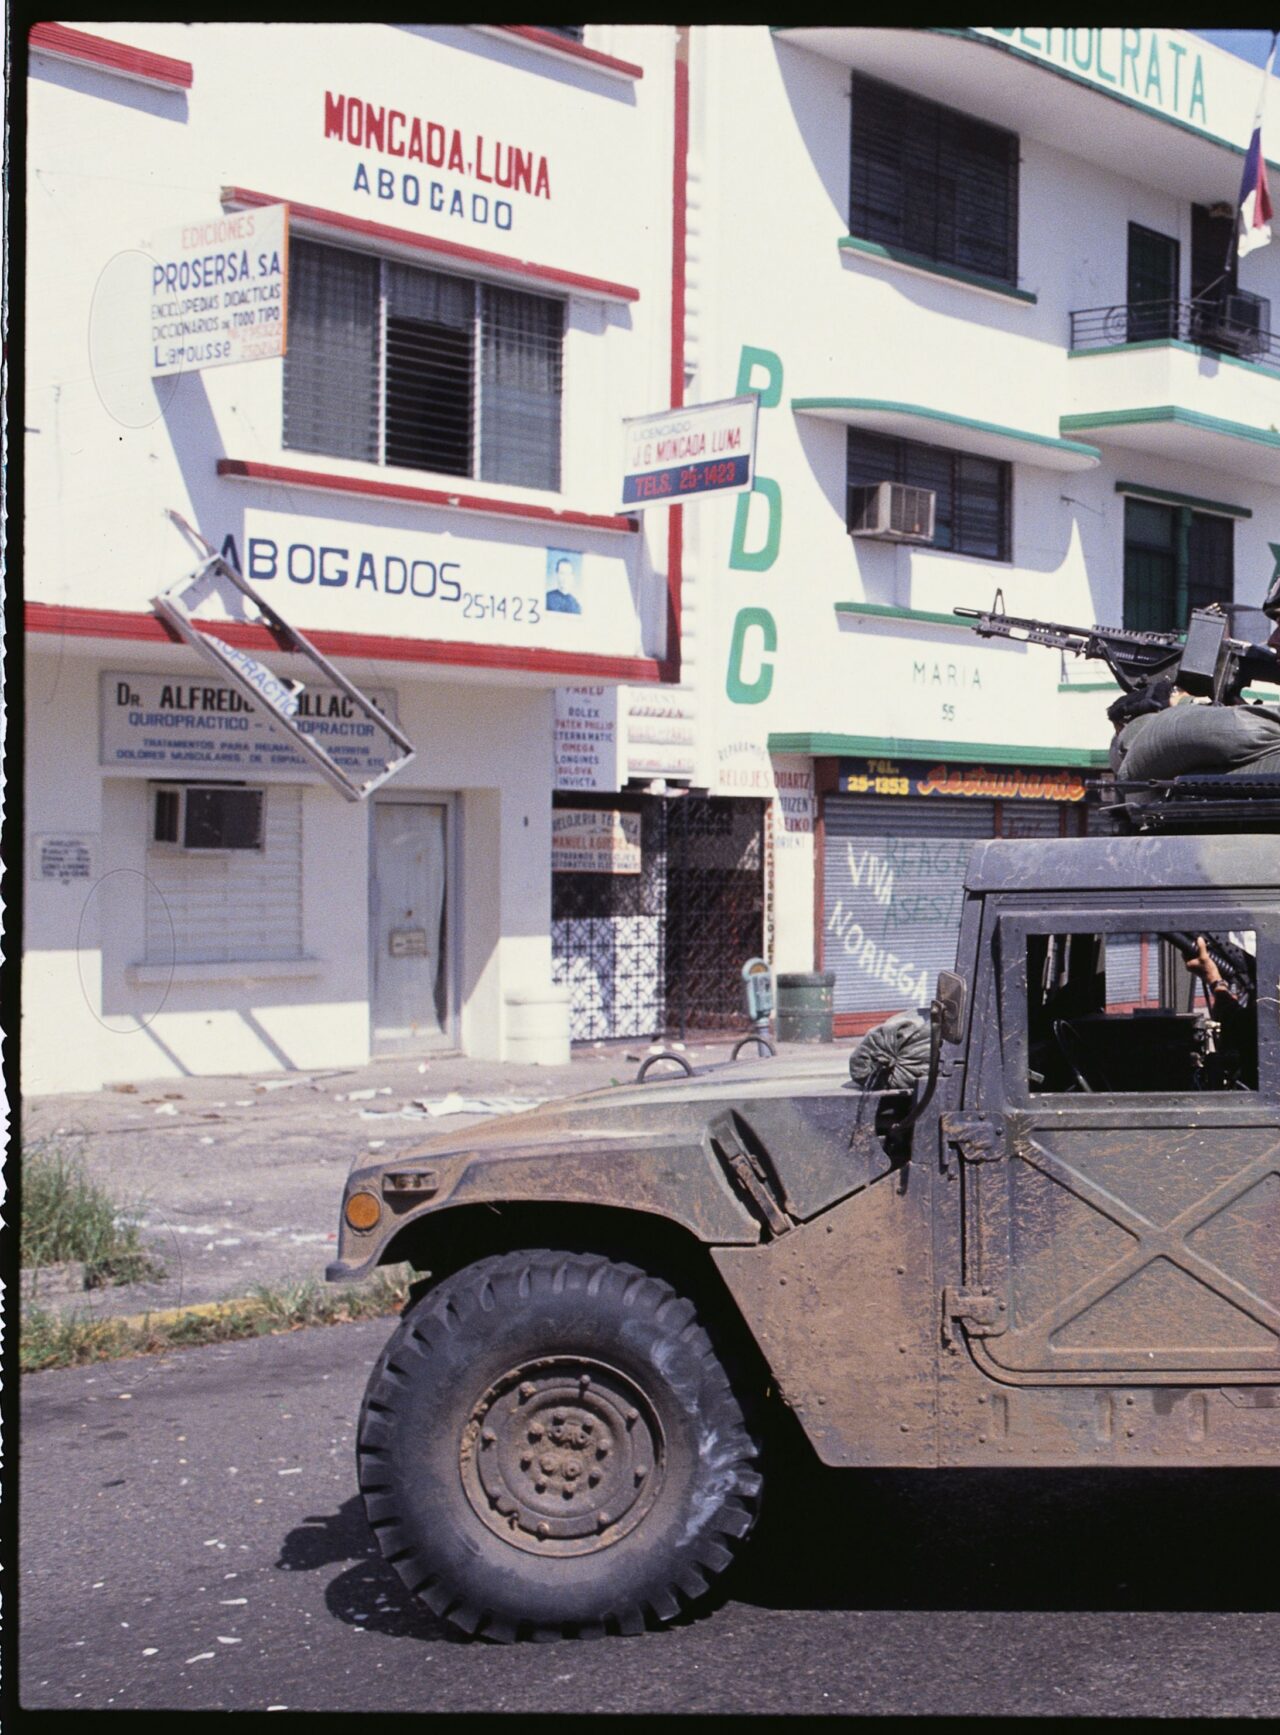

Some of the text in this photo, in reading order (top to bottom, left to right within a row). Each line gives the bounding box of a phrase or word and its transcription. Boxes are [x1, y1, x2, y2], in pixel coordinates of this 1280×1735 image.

[993, 28, 1206, 124] OCRATA
[324, 90, 464, 174] MONCADA
[476, 135, 550, 200] LUNA
[353, 162, 512, 231] ABOGADO
[181, 216, 255, 249] EDICIONES
[224, 283, 281, 308] DIDACTICAS
[152, 316, 219, 341] DICCIONARIOS
[233, 310, 255, 327] TODO
[258, 306, 280, 323] TIPO
[154, 341, 231, 368] Larousse
[655, 432, 705, 463] MONCADA
[711, 427, 741, 453] LUNA
[679, 462, 736, 490] 25-1423
[217, 533, 461, 602] ABOGADOS
[913, 660, 982, 690] MARIA
[128, 712, 249, 733] QUIROPRACTICO
[568, 706, 600, 718] ROLEX
[561, 743, 595, 753] OMEGA
[719, 769, 811, 789] RELOJES QUARTZ
[847, 840, 895, 906] VIVA
[827, 900, 930, 1010] NORIEGA
